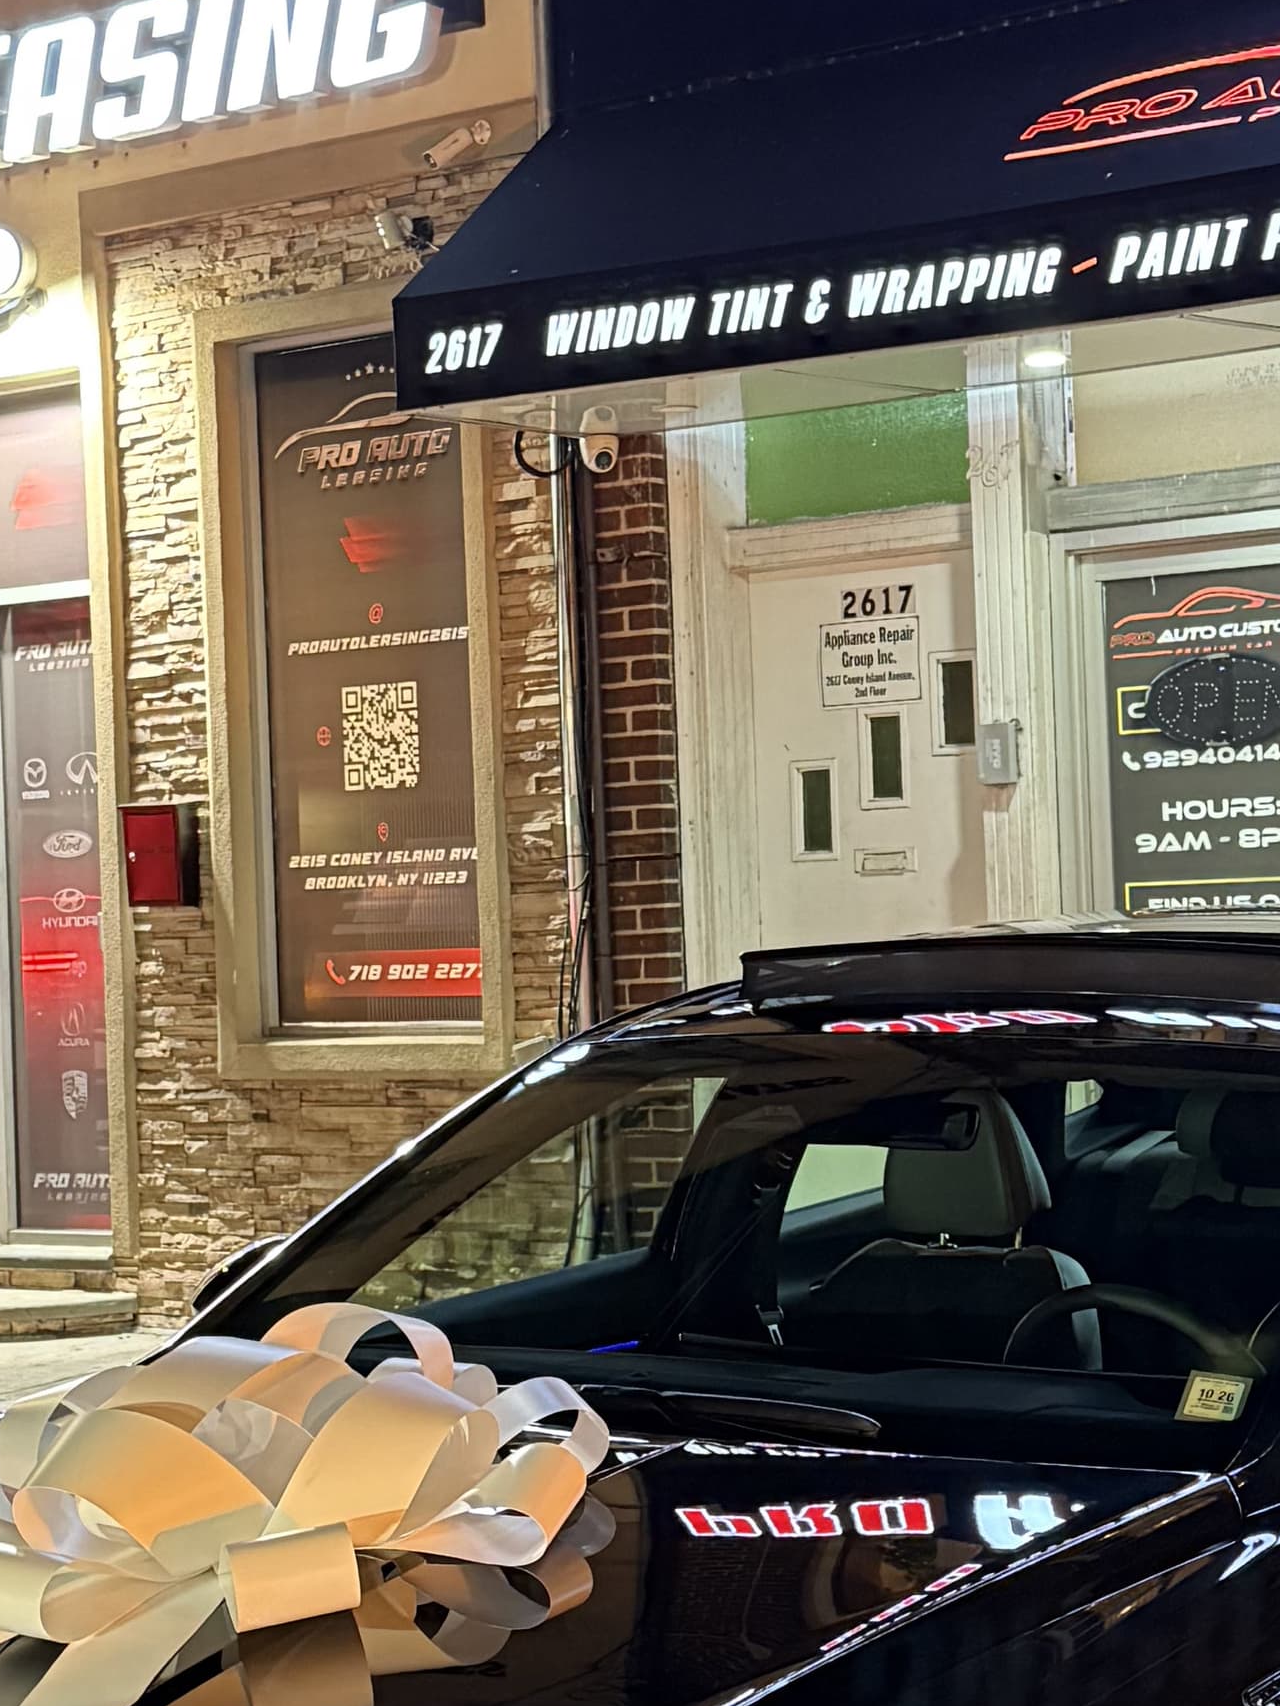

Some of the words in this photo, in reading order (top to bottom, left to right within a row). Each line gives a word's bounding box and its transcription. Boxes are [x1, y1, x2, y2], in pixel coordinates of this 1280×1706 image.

[1019, 88, 1197, 140] PRO
[543, 294, 694, 359] WINDOW
[706, 281, 795, 340] TINT
[803, 279, 827, 326] &
[848, 246, 1063, 321] WRAPPING
[1108, 216, 1248, 286] PAINT
[424, 322, 503, 376] 2617
[298, 440, 362, 473] PRO
[366, 427, 452, 463] AUTO
[321, 462, 427, 489] LEASING
[842, 585, 914, 619] 2617
[824, 629, 876, 650] Appliance
[879, 624, 915, 644] Repair
[1157, 626, 1217, 644] AUTO
[53, 639, 94, 657] AUT
[842, 651, 874, 668] Group
[877, 649, 897, 665] Inc.
[1135, 830, 1212, 853] 9AM
[289, 854, 326, 869] 2615
[330, 851, 383, 867] CONEY
[386, 849, 445, 864] ISLAND
[304, 874, 392, 890] BROOKLYN,
[397, 872, 418, 886] NY
[422, 870, 468, 885] 11223
[348, 964, 382, 981] 718
[387, 963, 429, 979] 902
[34, 1173, 69, 1189] PRO
[1199, 1388, 1214, 1399] 10
